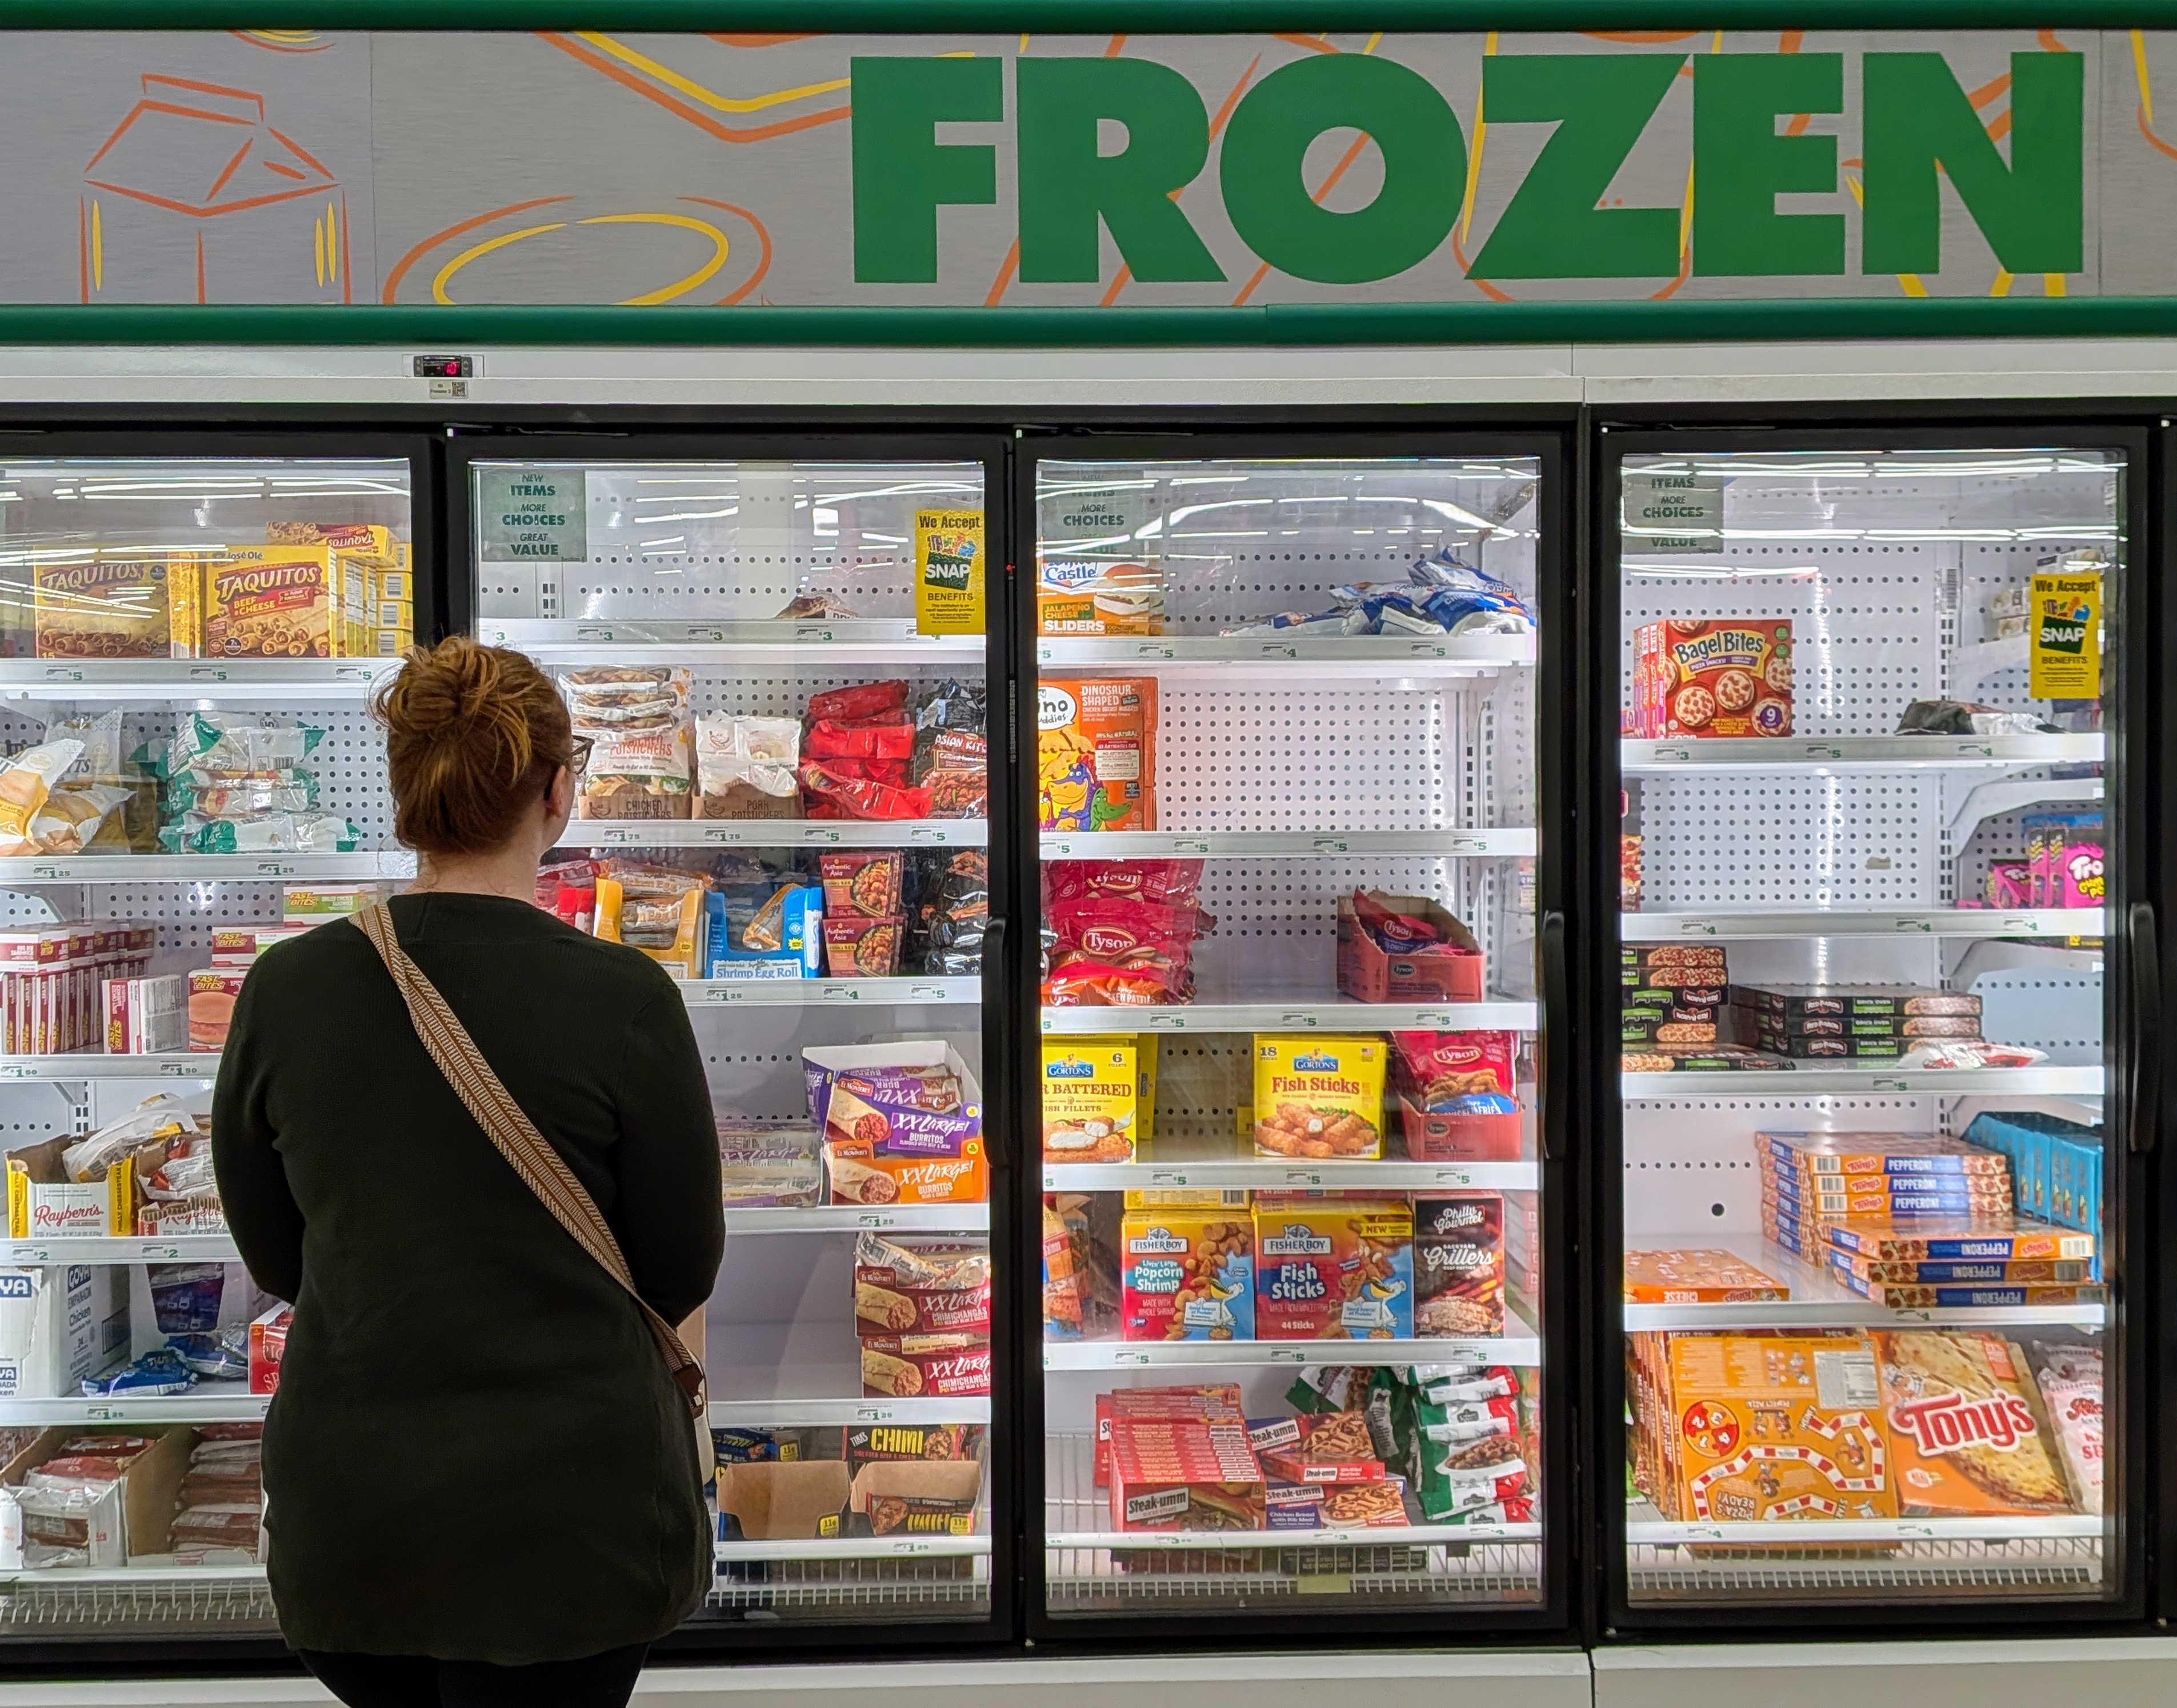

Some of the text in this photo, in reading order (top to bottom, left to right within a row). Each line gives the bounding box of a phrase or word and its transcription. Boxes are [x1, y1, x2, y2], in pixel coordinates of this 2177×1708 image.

[851, 53, 2083, 283] FROZEN
[522, 474, 543, 482] NEW
[1651, 478, 1695, 489] ITEMS
[510, 485, 555, 496] ITEMS
[1661, 496, 1686, 504] MORE
[521, 503, 546, 512] MORE
[1081, 504, 1107, 513] MORE
[1643, 507, 1704, 518] CHOICES
[502, 514, 565, 526] CHOICES
[919, 515, 980, 530] We Accept
[1063, 515, 1124, 526] CHOICES
[328, 531, 374, 547] TAQUITOS
[519, 533, 549, 542] GREAT
[1651, 537, 1697, 547] VALUE
[247, 551, 263, 559] Olé
[510, 544, 558, 555] VALUE
[41, 563, 143, 591] TAQUITOS
[925, 563, 970, 579] SNAP
[1045, 566, 1096, 583] Castle
[216, 566, 318, 599] TAQUITOS
[2035, 580, 2096, 593] We Accept
[233, 595, 257, 610] BEEF
[927, 593, 974, 601] BENEFITS
[239, 600, 275, 616] CHEESE
[1045, 611, 1079, 619] CHEESE
[1044, 620, 1105, 631] SLIDERS
[2040, 627, 2085, 642] SNAP
[1675, 631, 1764, 664] Bagel Bites
[1691, 662, 1706, 670] PIZZA
[2042, 656, 2087, 664] BENEFITS
[1082, 695, 1119, 706] SHAPED
[1766, 707, 1776, 722] 9
[935, 734, 964, 748] ASIAN
[610, 743, 673, 757] POTSTICKERS
[626, 800, 663, 810] CHICKEN
[618, 810, 672, 820] POTSTICKERS
[731, 810, 785, 820] POTSTICKERS
[823, 863, 851, 871] Authentic
[1388, 922, 1410, 937] Tyson
[1087, 931, 1132, 951] Tyson
[716, 966, 798, 979] Shrimp Egg Roll
[1127, 993, 1156, 1004] PATTIES
[1707, 994, 1719, 1002] RED
[1696, 1011, 1708, 1019] RED
[1259, 1046, 1278, 1057] 18
[1811, 1042, 1823, 1050] RED
[1112, 1053, 1123, 1063] 6
[1438, 1048, 1481, 1063] Tyson
[1053, 1083, 1132, 1098] BATTERED
[1272, 1076, 1360, 1095] Fish Sticks
[909, 1132, 945, 1144] BURRITOS
[1888, 1159, 1932, 1171] PEPPERONI
[917, 1181, 953, 1195] BURRITOS
[1893, 1178, 1937, 1190] PEPPERONI
[1895, 1197, 1939, 1209] PEPPERONI
[1443, 1205, 1477, 1221] Philly
[1366, 1225, 1387, 1234] NEW
[1434, 1213, 1485, 1234] Gourmet
[1135, 1240, 1183, 1251] FISHER BOY
[1270, 1241, 1326, 1250] FISHER BOY
[1961, 1242, 2008, 1255] PEPPERONI
[1423, 1246, 1496, 1271] Grillers
[69, 1265, 91, 1289] GOYA
[1134, 1265, 1183, 1281] Popcorn
[1280, 1263, 1317, 1282] Fish
[1136, 1278, 1180, 1292] Shrimp
[1272, 1281, 1326, 1299] Sticks
[1142, 1299, 1171, 1307] MADE WITH
[1664, 1291, 1699, 1303] CHEESE
[932, 1306, 988, 1322] CHIMICHANGAS
[1138, 1307, 1175, 1316] WHOLE SHRIMP
[1281, 1321, 1315, 1330] 44 Sticks
[1691, 1416, 1706, 1429] 2
[1710, 1411, 1724, 1426] 3
[1892, 1392, 2035, 1451] Tony's
[871, 1428, 924, 1454] CHIMI
[1306, 1469, 1336, 1477] Steak-umm
[1266, 1486, 1321, 1500] Steak-umm
[1128, 1491, 1187, 1514] Steak-umm
[1718, 1491, 1755, 1509] READY!
[1716, 1503, 1753, 1522] PIZZA'S
